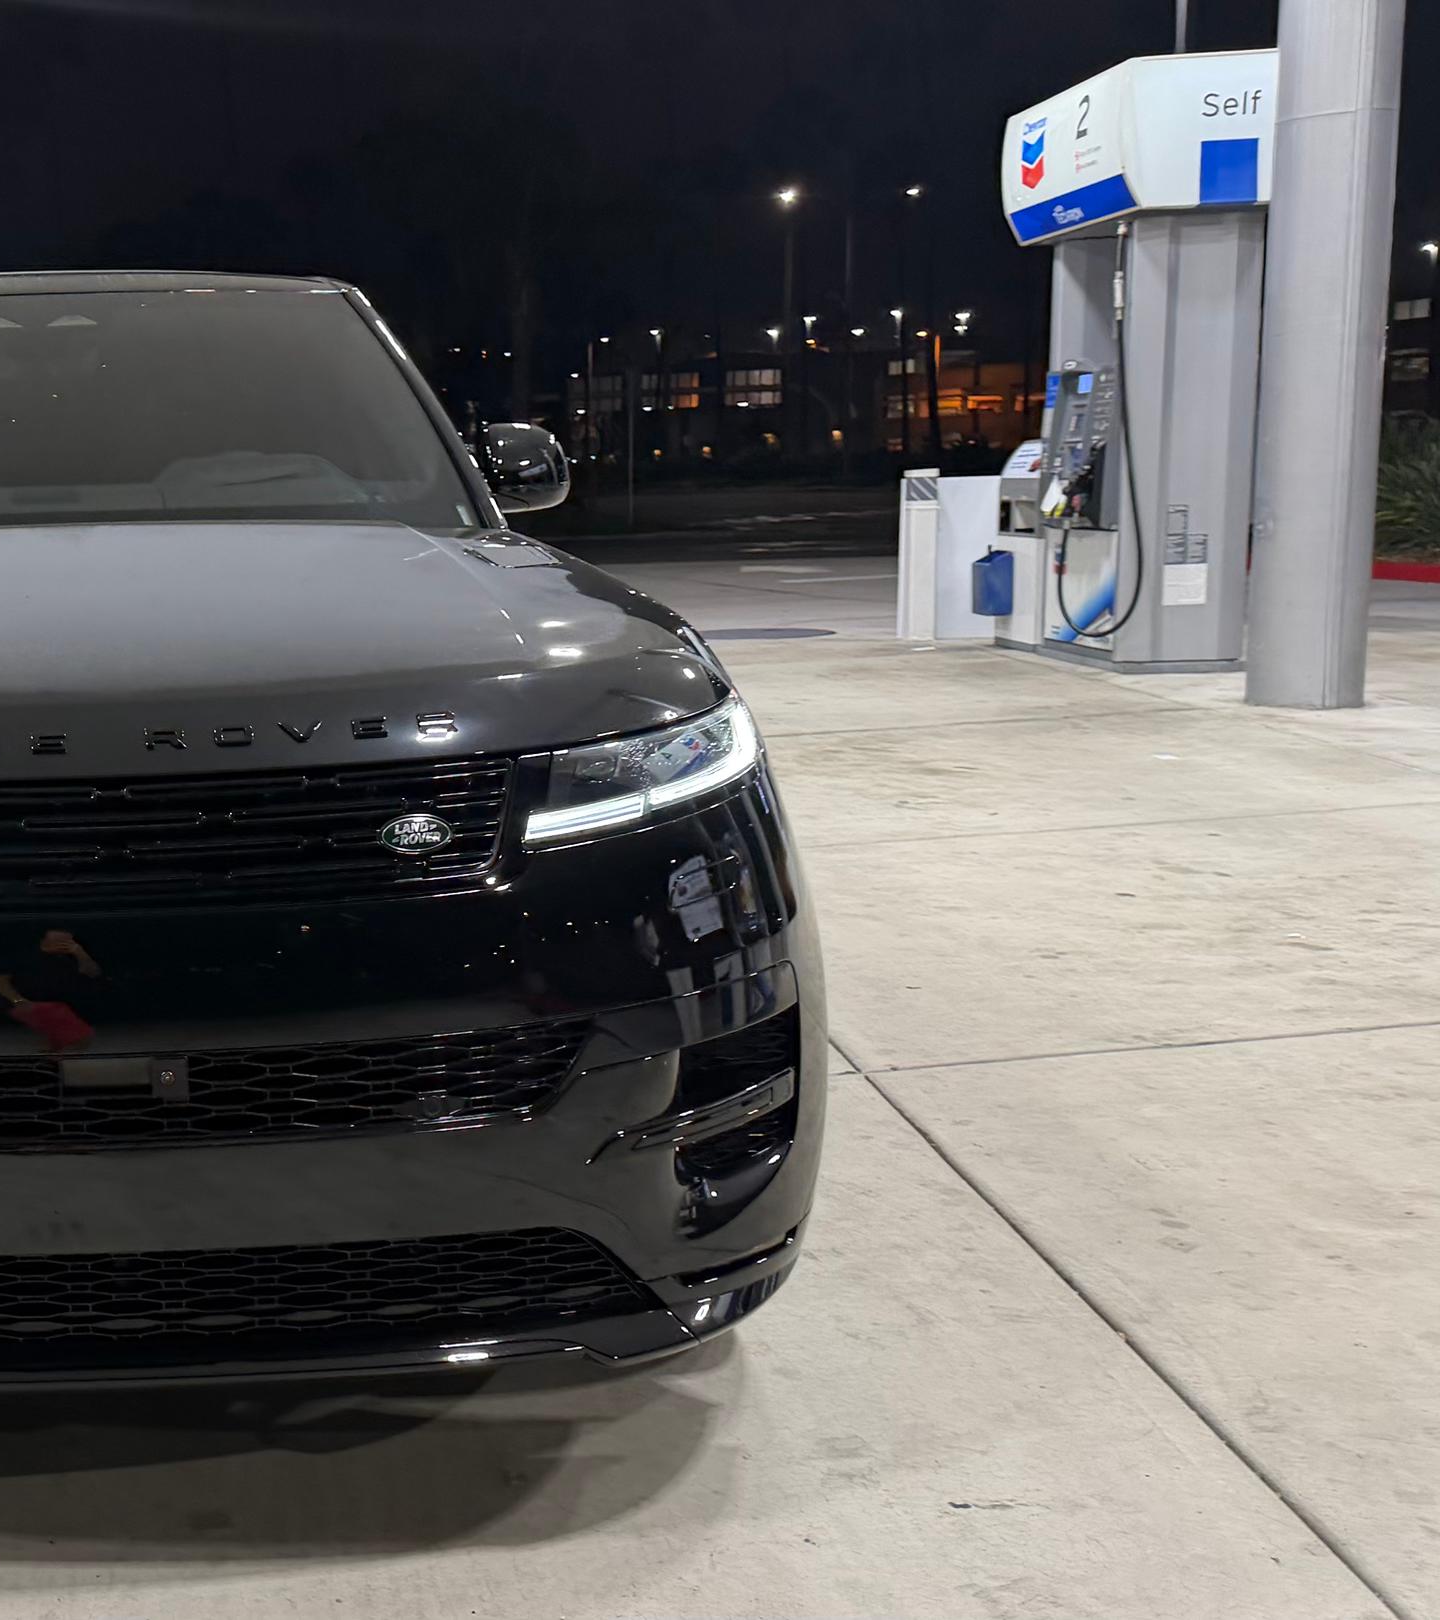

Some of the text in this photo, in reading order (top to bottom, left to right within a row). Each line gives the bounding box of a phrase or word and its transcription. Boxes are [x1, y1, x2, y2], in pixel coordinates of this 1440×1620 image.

[1075, 94, 1090, 140] 2
[1202, 89, 1262, 118] Self
[143, 710, 459, 750] ROVER
[394, 821, 430, 836] LAND
[399, 832, 442, 845] ROVER
